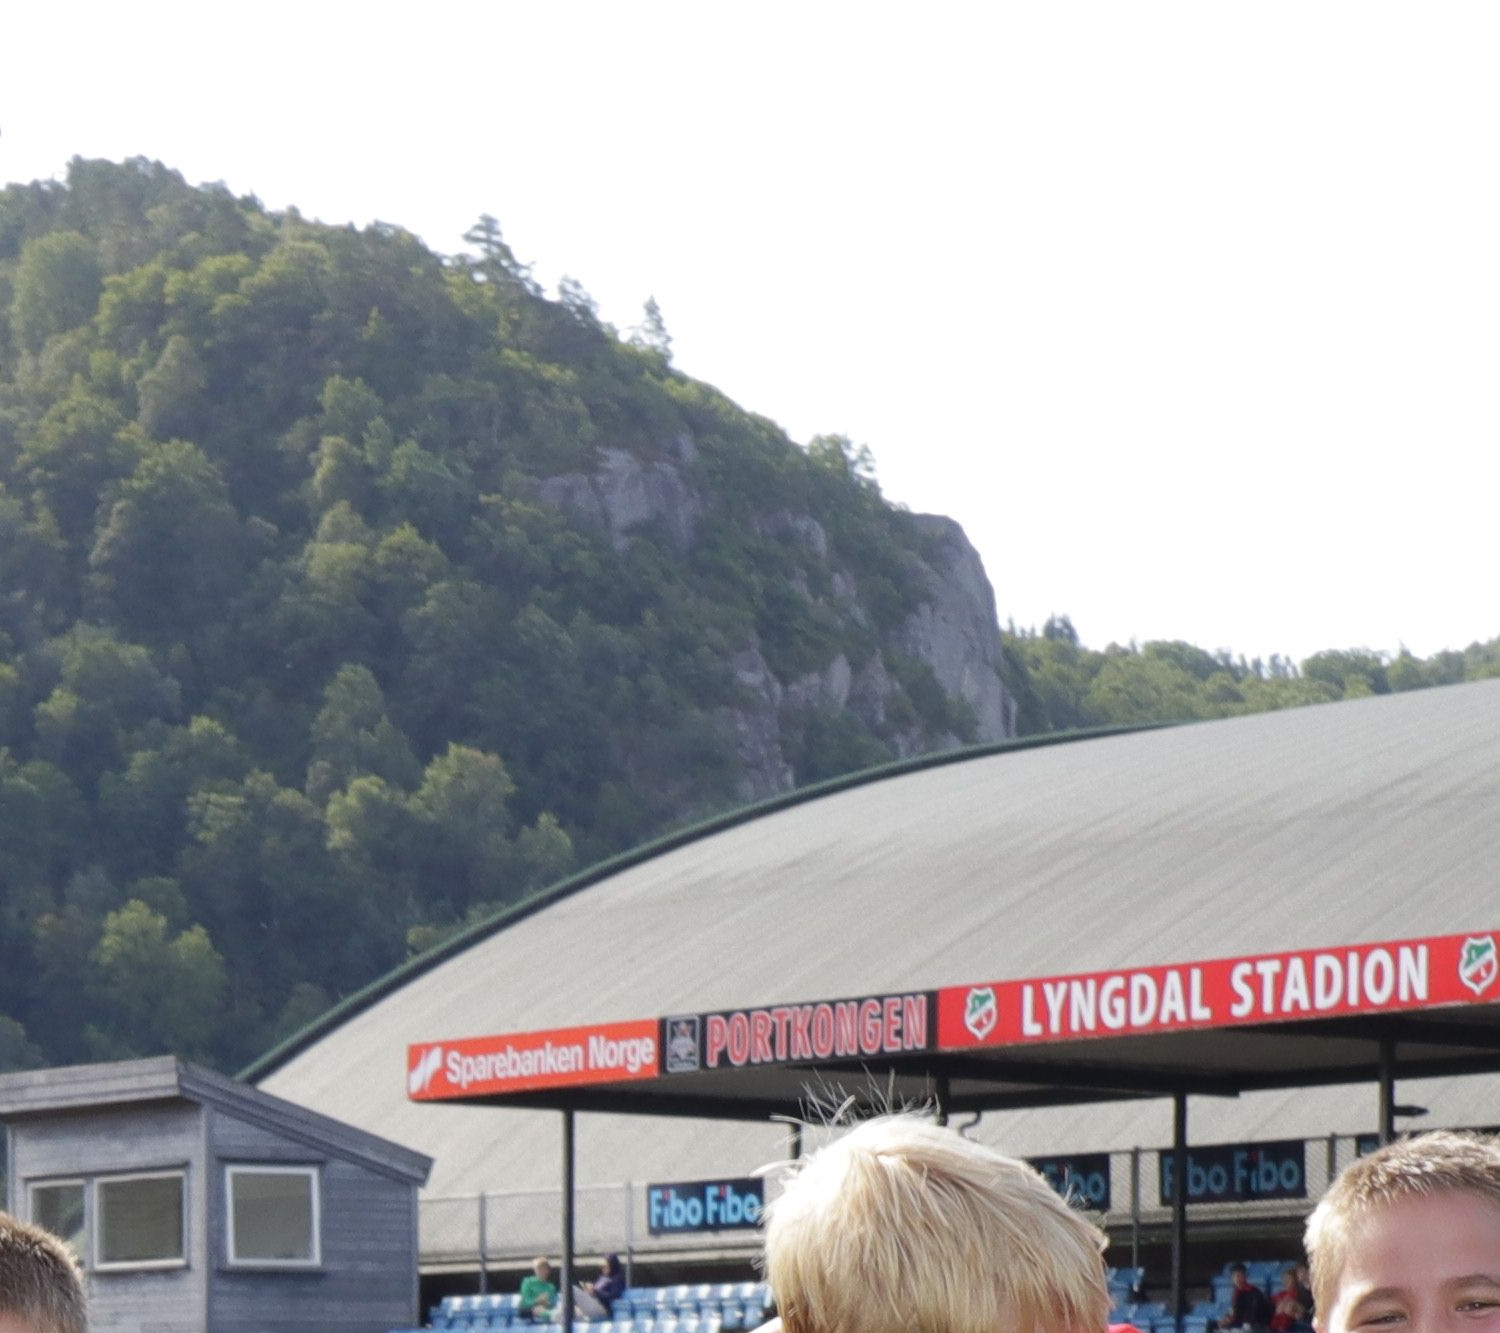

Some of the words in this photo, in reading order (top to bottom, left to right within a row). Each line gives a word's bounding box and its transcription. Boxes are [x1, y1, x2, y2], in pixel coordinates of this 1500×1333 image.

[1021, 966, 1211, 1037] LYNGDAL
[1229, 942, 1431, 1016] STADION
[705, 993, 928, 1067] PORTKONGEN
[445, 1043, 583, 1088] Sparebanken
[588, 1032, 656, 1075] Norge
[1163, 1156, 1228, 1198] Fbo
[1234, 1150, 1300, 1194] Fibo
[651, 1188, 703, 1228] Fibo
